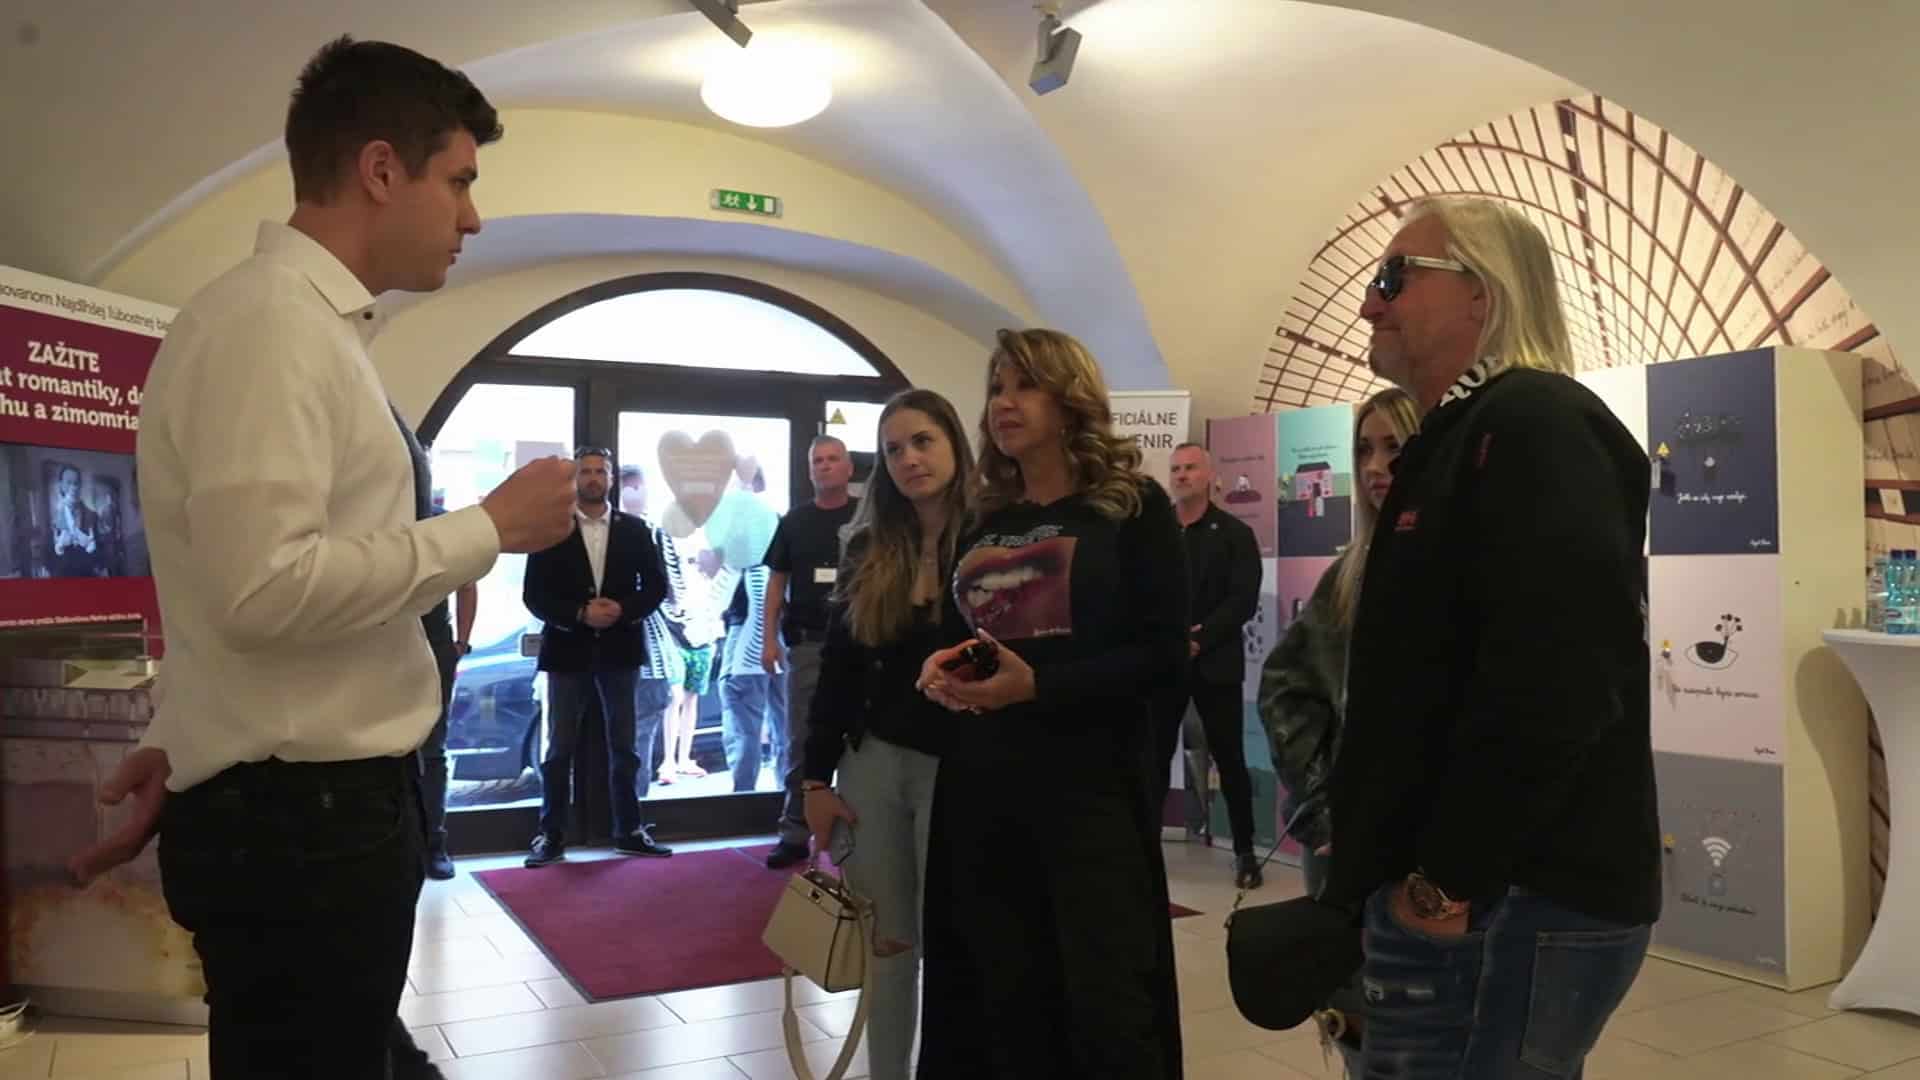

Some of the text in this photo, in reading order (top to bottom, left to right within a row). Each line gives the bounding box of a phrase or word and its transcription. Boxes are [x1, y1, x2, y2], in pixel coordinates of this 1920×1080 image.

[28, 341, 100, 373] ZAŽITE
[17, 372, 123, 407] romantiky,
[34, 402, 47, 419] a
